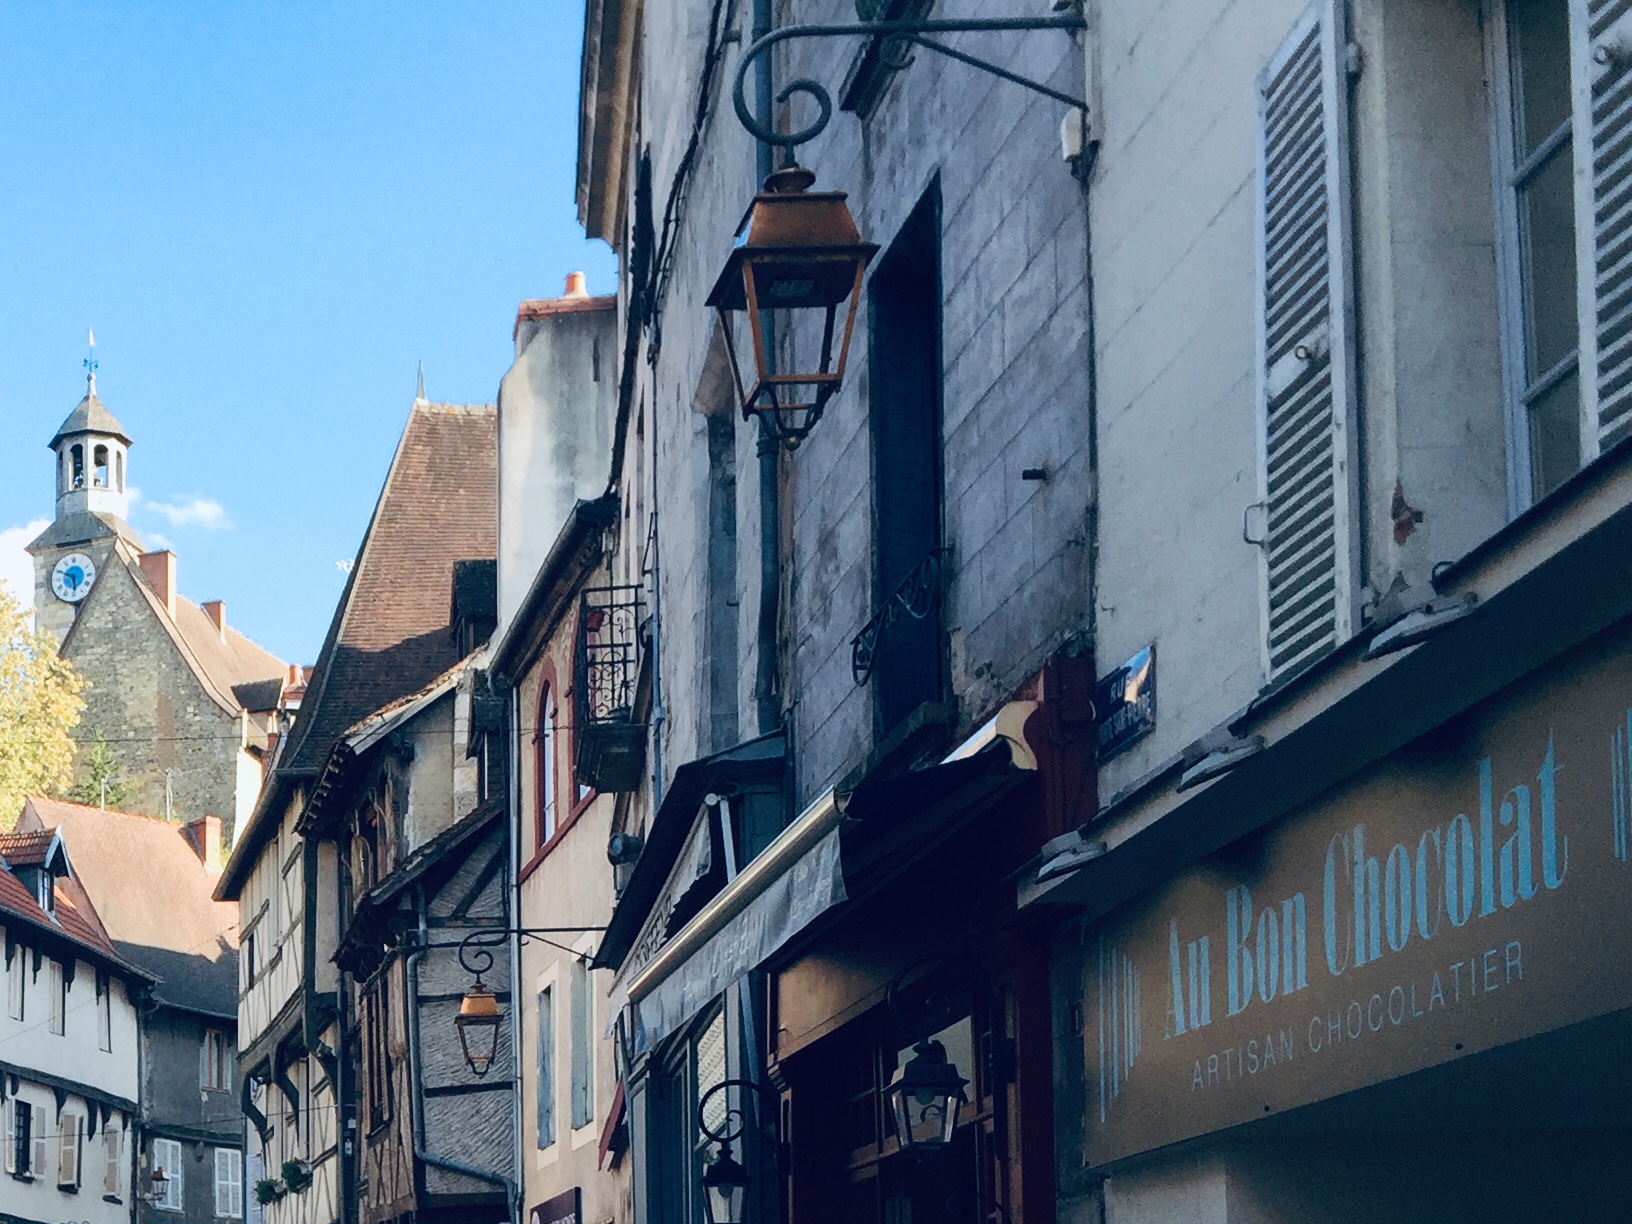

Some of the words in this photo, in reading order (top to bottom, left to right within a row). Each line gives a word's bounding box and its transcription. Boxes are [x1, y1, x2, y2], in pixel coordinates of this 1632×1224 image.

[1163, 917, 1212, 1041] Au
[1225, 884, 1309, 1018] Bon
[1323, 726, 1569, 977] Chocolat
[1191, 1034, 1295, 1092] ARTISAN
[1307, 941, 1524, 1054] CHOCOLATIER
